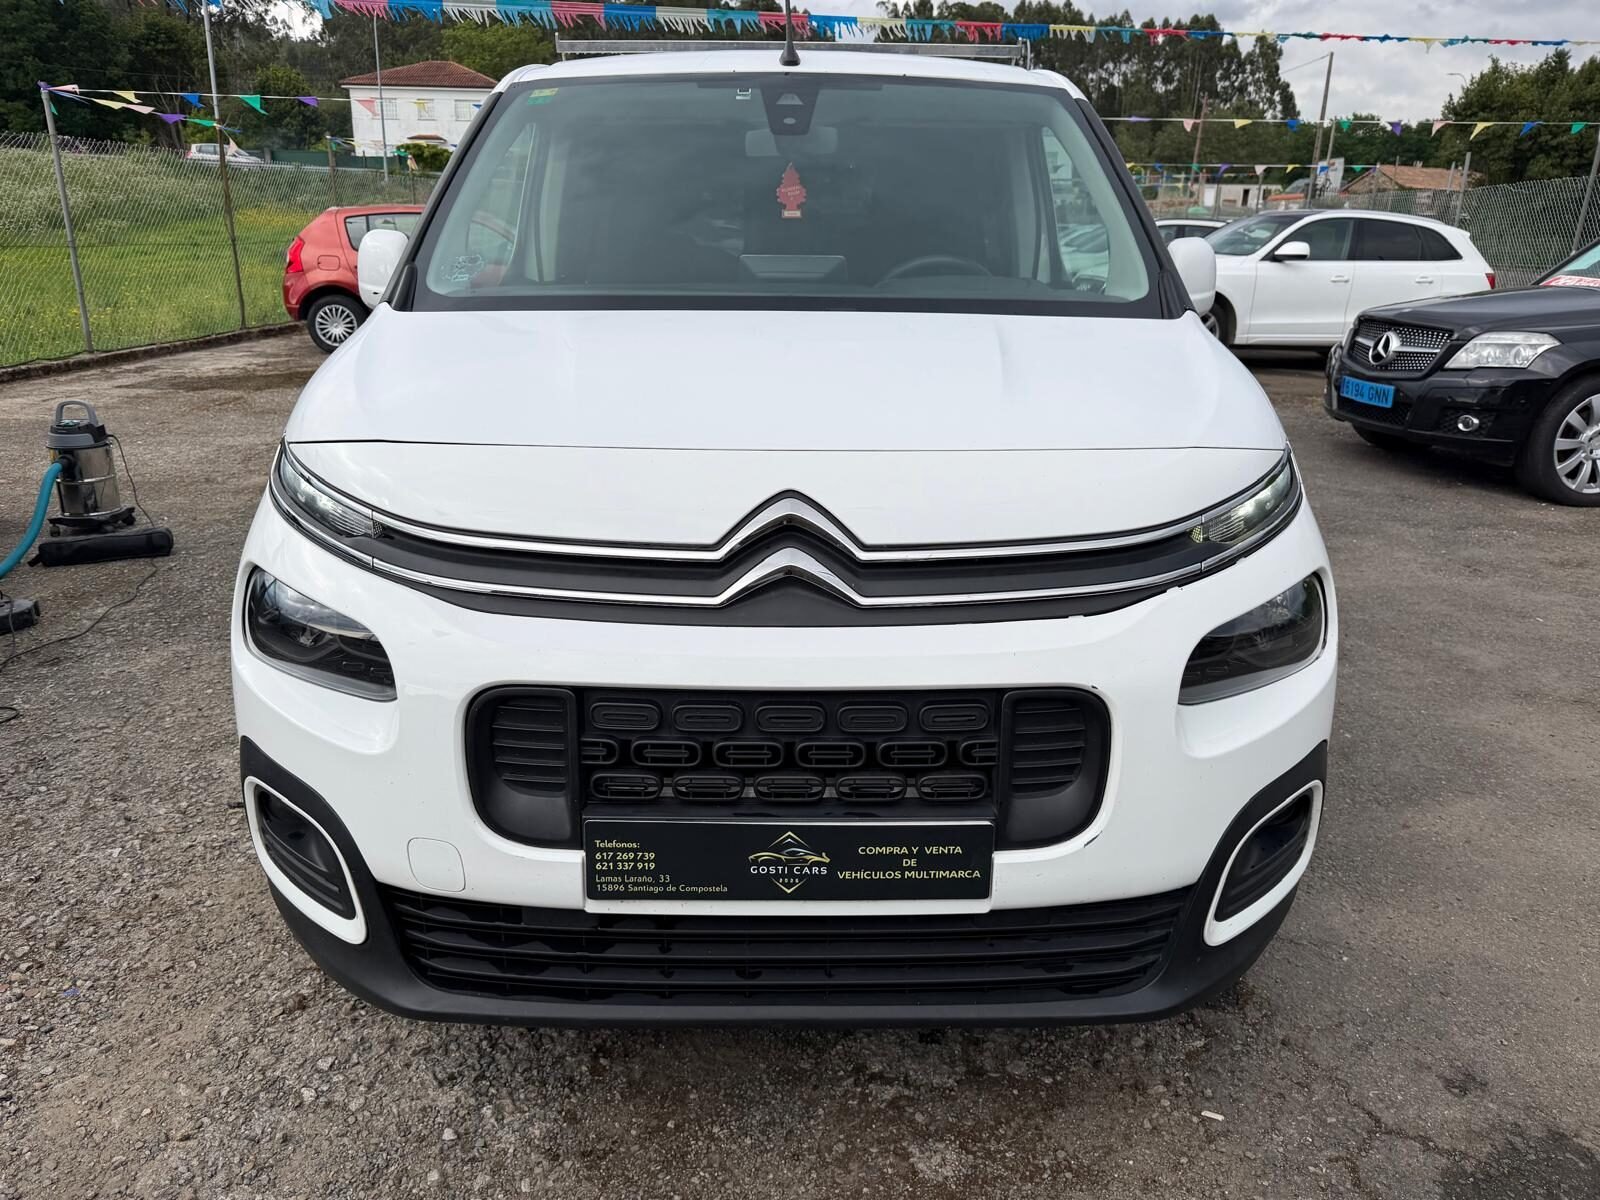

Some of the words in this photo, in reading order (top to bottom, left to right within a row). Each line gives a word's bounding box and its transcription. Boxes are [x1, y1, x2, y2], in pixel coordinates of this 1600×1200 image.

[1368, 386, 1390, 403] GNN
[595, 840, 640, 848] Telefonos:
[858, 846, 908, 855] COMPRA
[595, 852, 613, 860] 617
[616, 852, 634, 860] 269
[636, 852, 655, 860] 739
[595, 862, 613, 870] 621
[616, 862, 633, 870] 337
[638, 862, 655, 870] 919
[902, 859, 917, 867] DE
[750, 866, 788, 875] GOSTI
[793, 866, 828, 875] CARS
[837, 870, 902, 880] VEHÍCULOS
[905, 870, 981, 879] MULTIMARCA
[595, 874, 622, 883] Lamas
[596, 884, 625, 892] 15896
[628, 885, 664, 894] Santiago
[679, 885, 727, 893] Compostela
